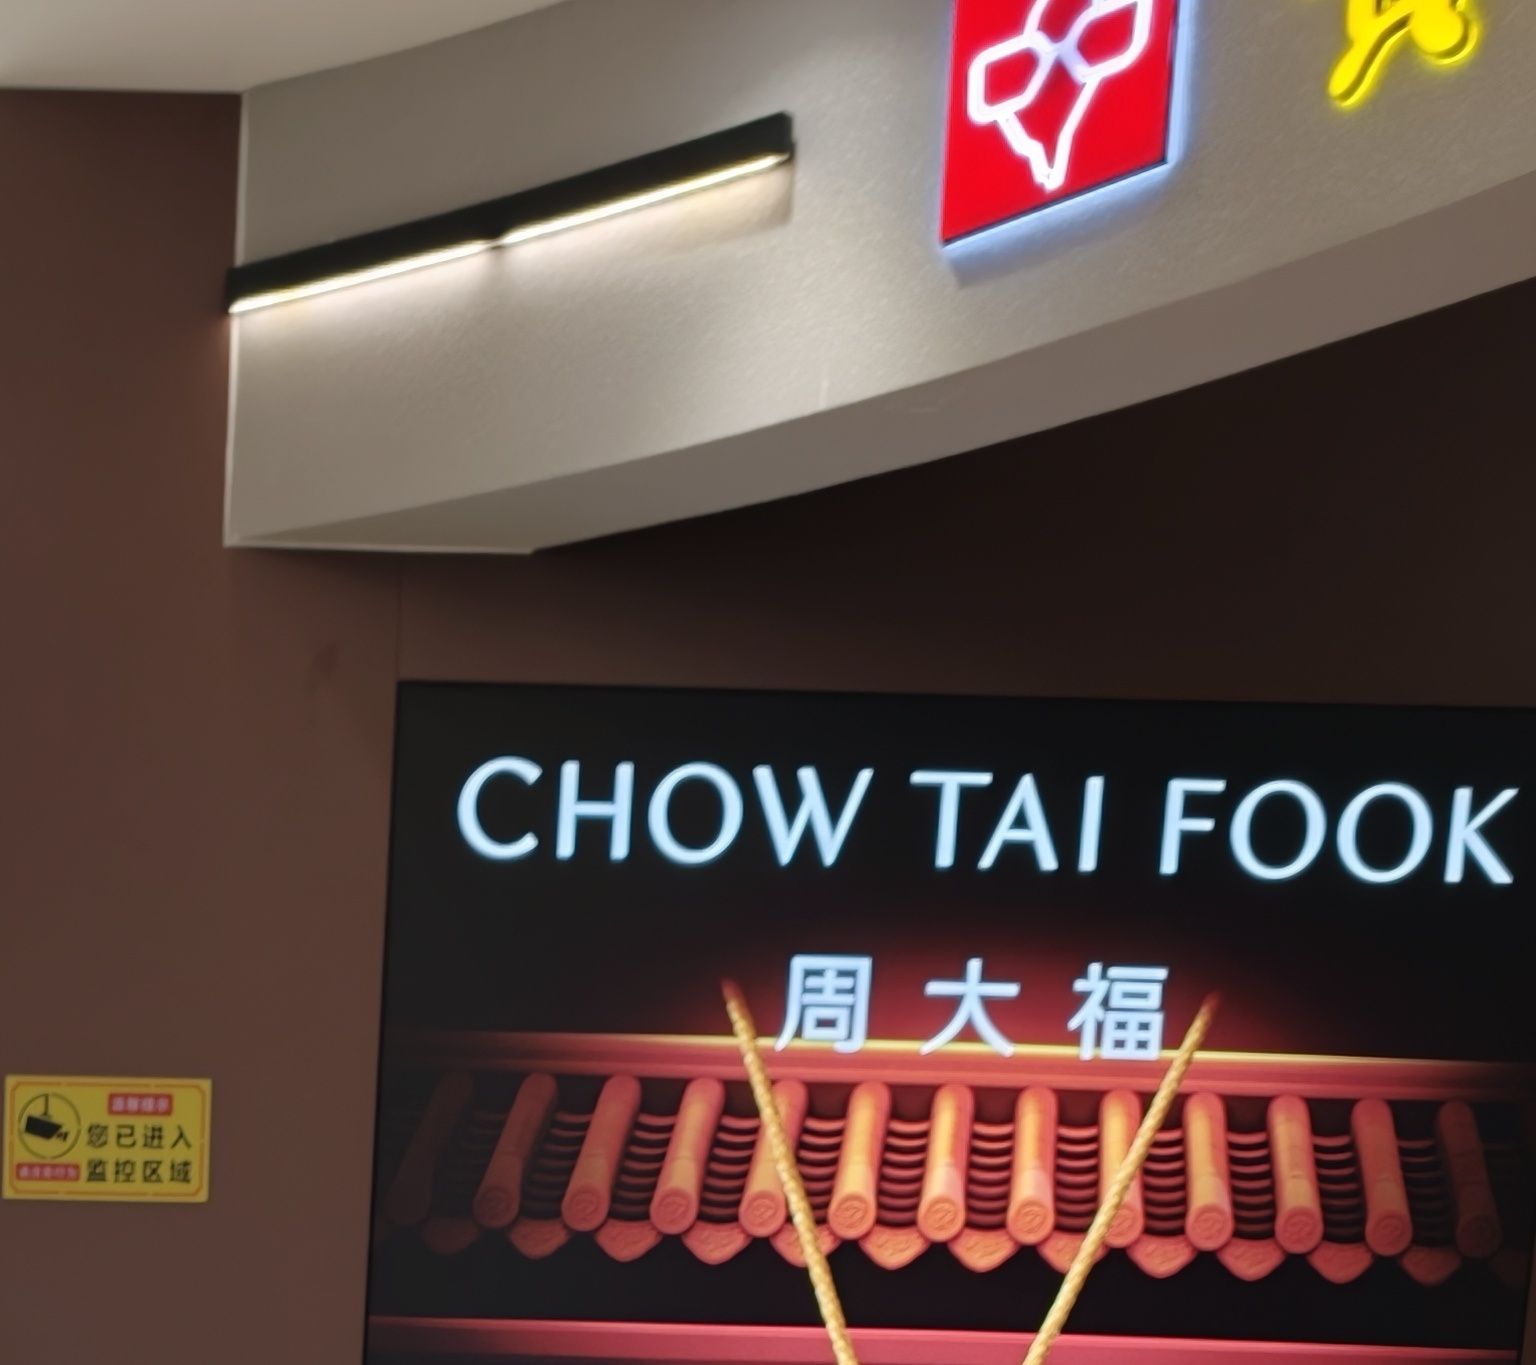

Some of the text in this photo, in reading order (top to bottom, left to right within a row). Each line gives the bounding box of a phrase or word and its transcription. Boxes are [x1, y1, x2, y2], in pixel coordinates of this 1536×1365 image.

[455, 754, 1520, 886] CHOW TAI FOOK
[773, 952, 1170, 1062] 周大福
[86, 1124, 193, 1150] 您已进入
[86, 1159, 193, 1184] 监控区域
